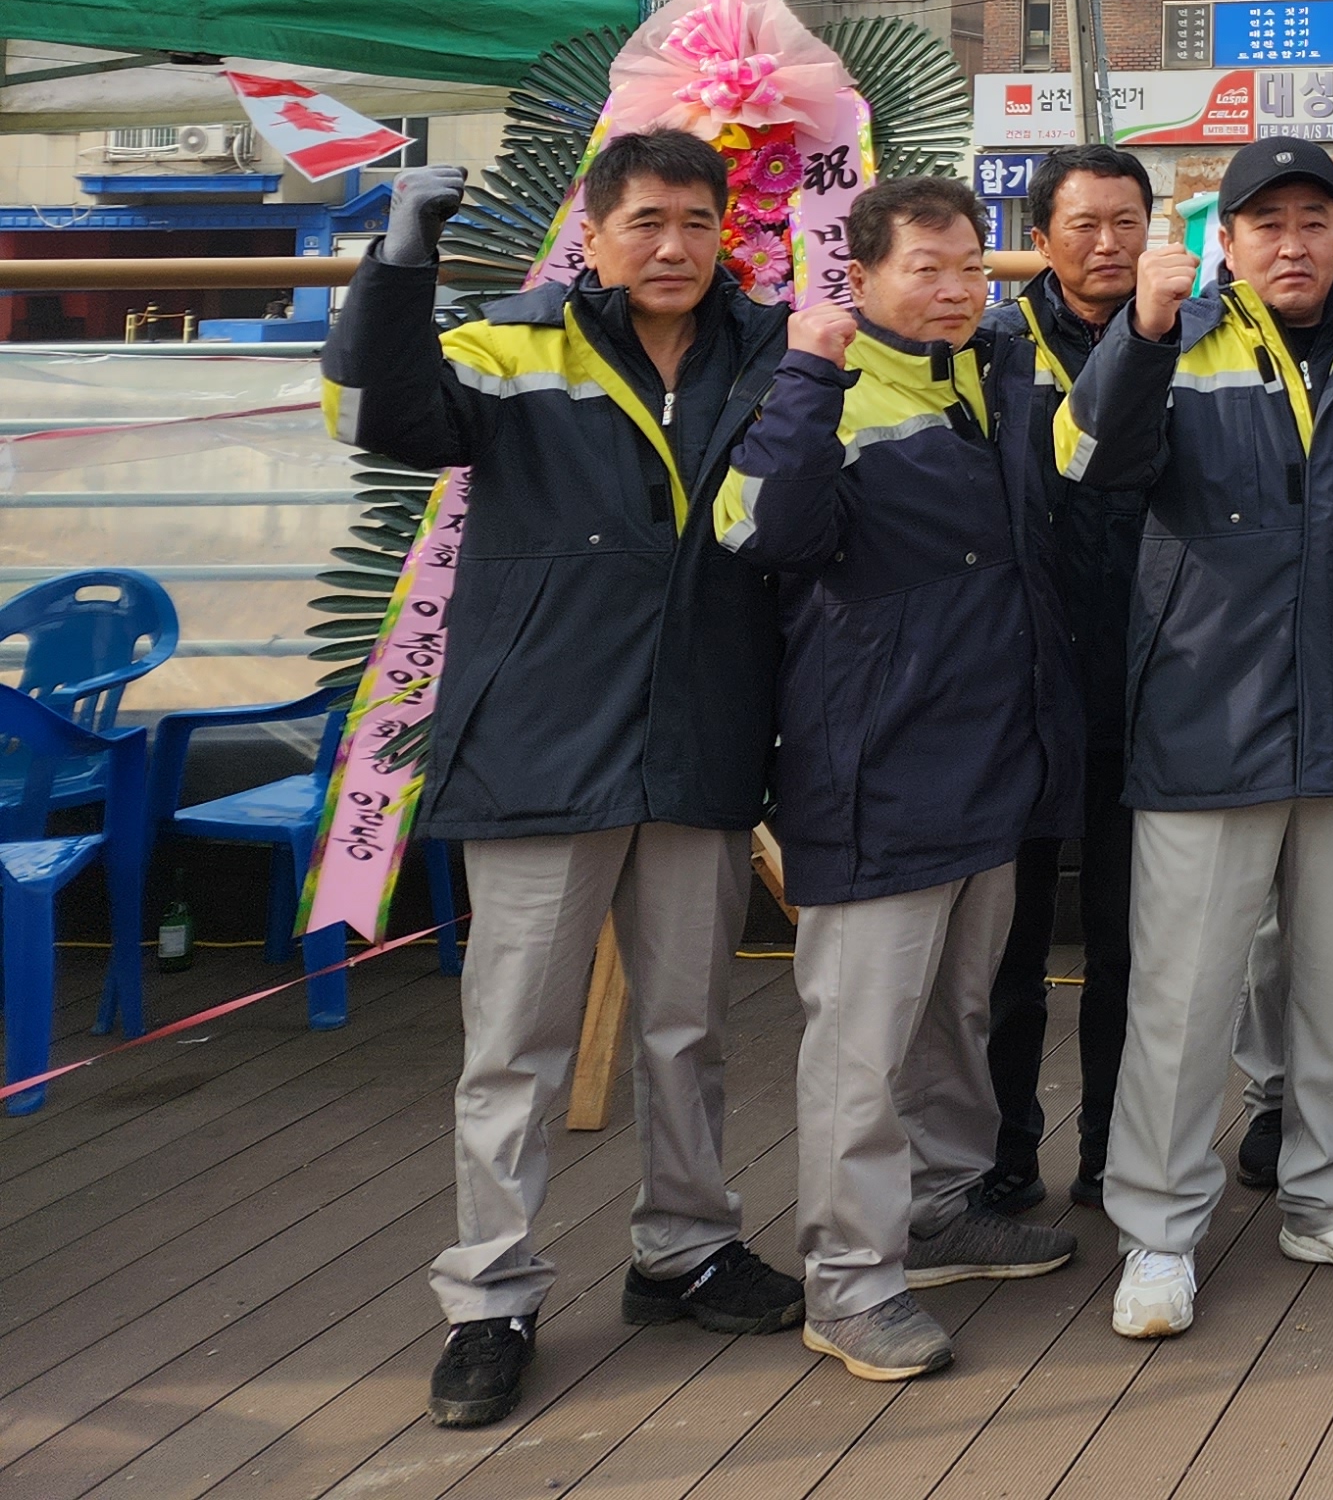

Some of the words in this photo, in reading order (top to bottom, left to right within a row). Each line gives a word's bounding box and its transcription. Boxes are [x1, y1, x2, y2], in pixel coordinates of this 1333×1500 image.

[1207, 109, 1249, 119] CELLO
[1303, 124, 1322, 139] A/S
[802, 145, 858, 195] 祝
